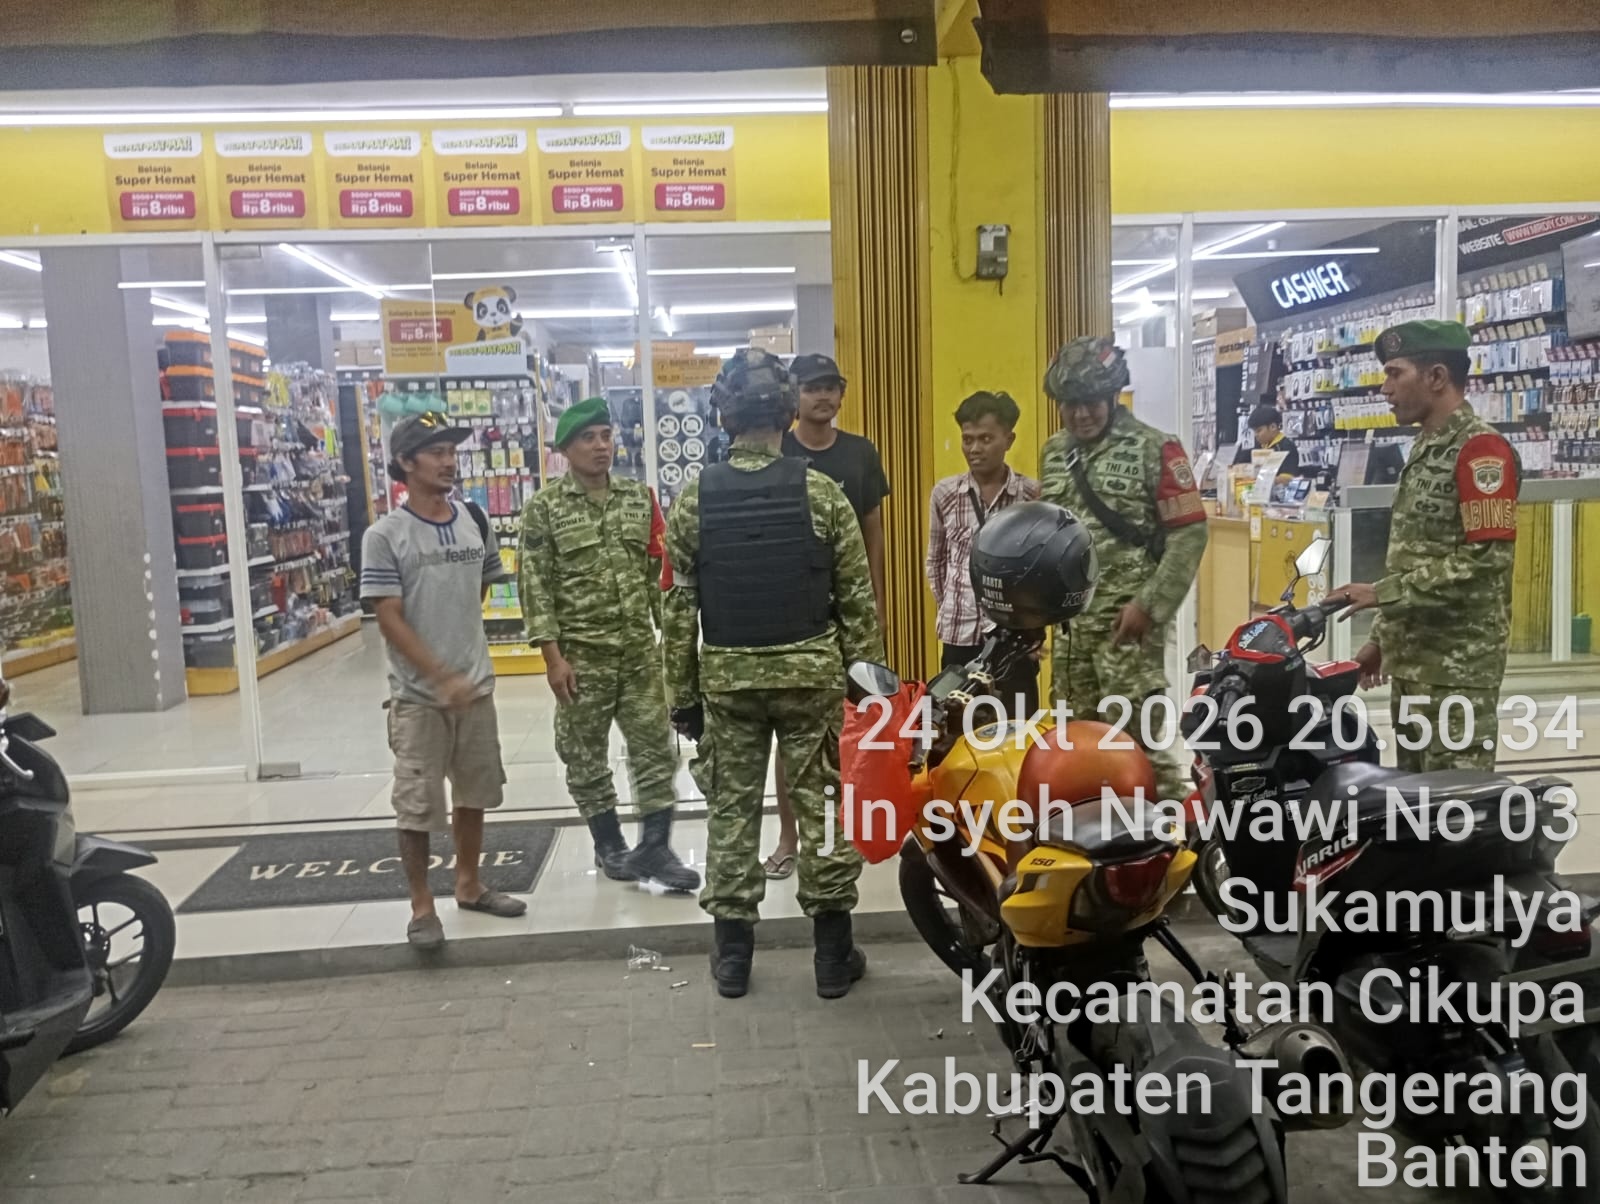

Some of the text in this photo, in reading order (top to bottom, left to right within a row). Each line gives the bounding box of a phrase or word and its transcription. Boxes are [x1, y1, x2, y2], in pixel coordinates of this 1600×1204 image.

[248, 163, 282, 172] Belanja
[357, 163, 390, 172] Belanja
[465, 161, 498, 170] Belanja
[569, 159, 602, 168] Belanja
[672, 158, 705, 166] Belanja
[138, 165, 172, 174] Belanja
[548, 168, 624, 180] Super Hemat
[651, 167, 727, 178] Super Hemat
[115, 174, 196, 187] Super Hemat
[226, 173, 306, 184] Super Hemat
[335, 173, 414, 184] Super Hemat
[443, 171, 520, 183] Super Hemat
[1271, 262, 1350, 308] CASHIER
[1105, 463, 1139, 476] TNI AD
[1417, 478, 1454, 494] TNI AD
[1030, 857, 1056, 867] 150
